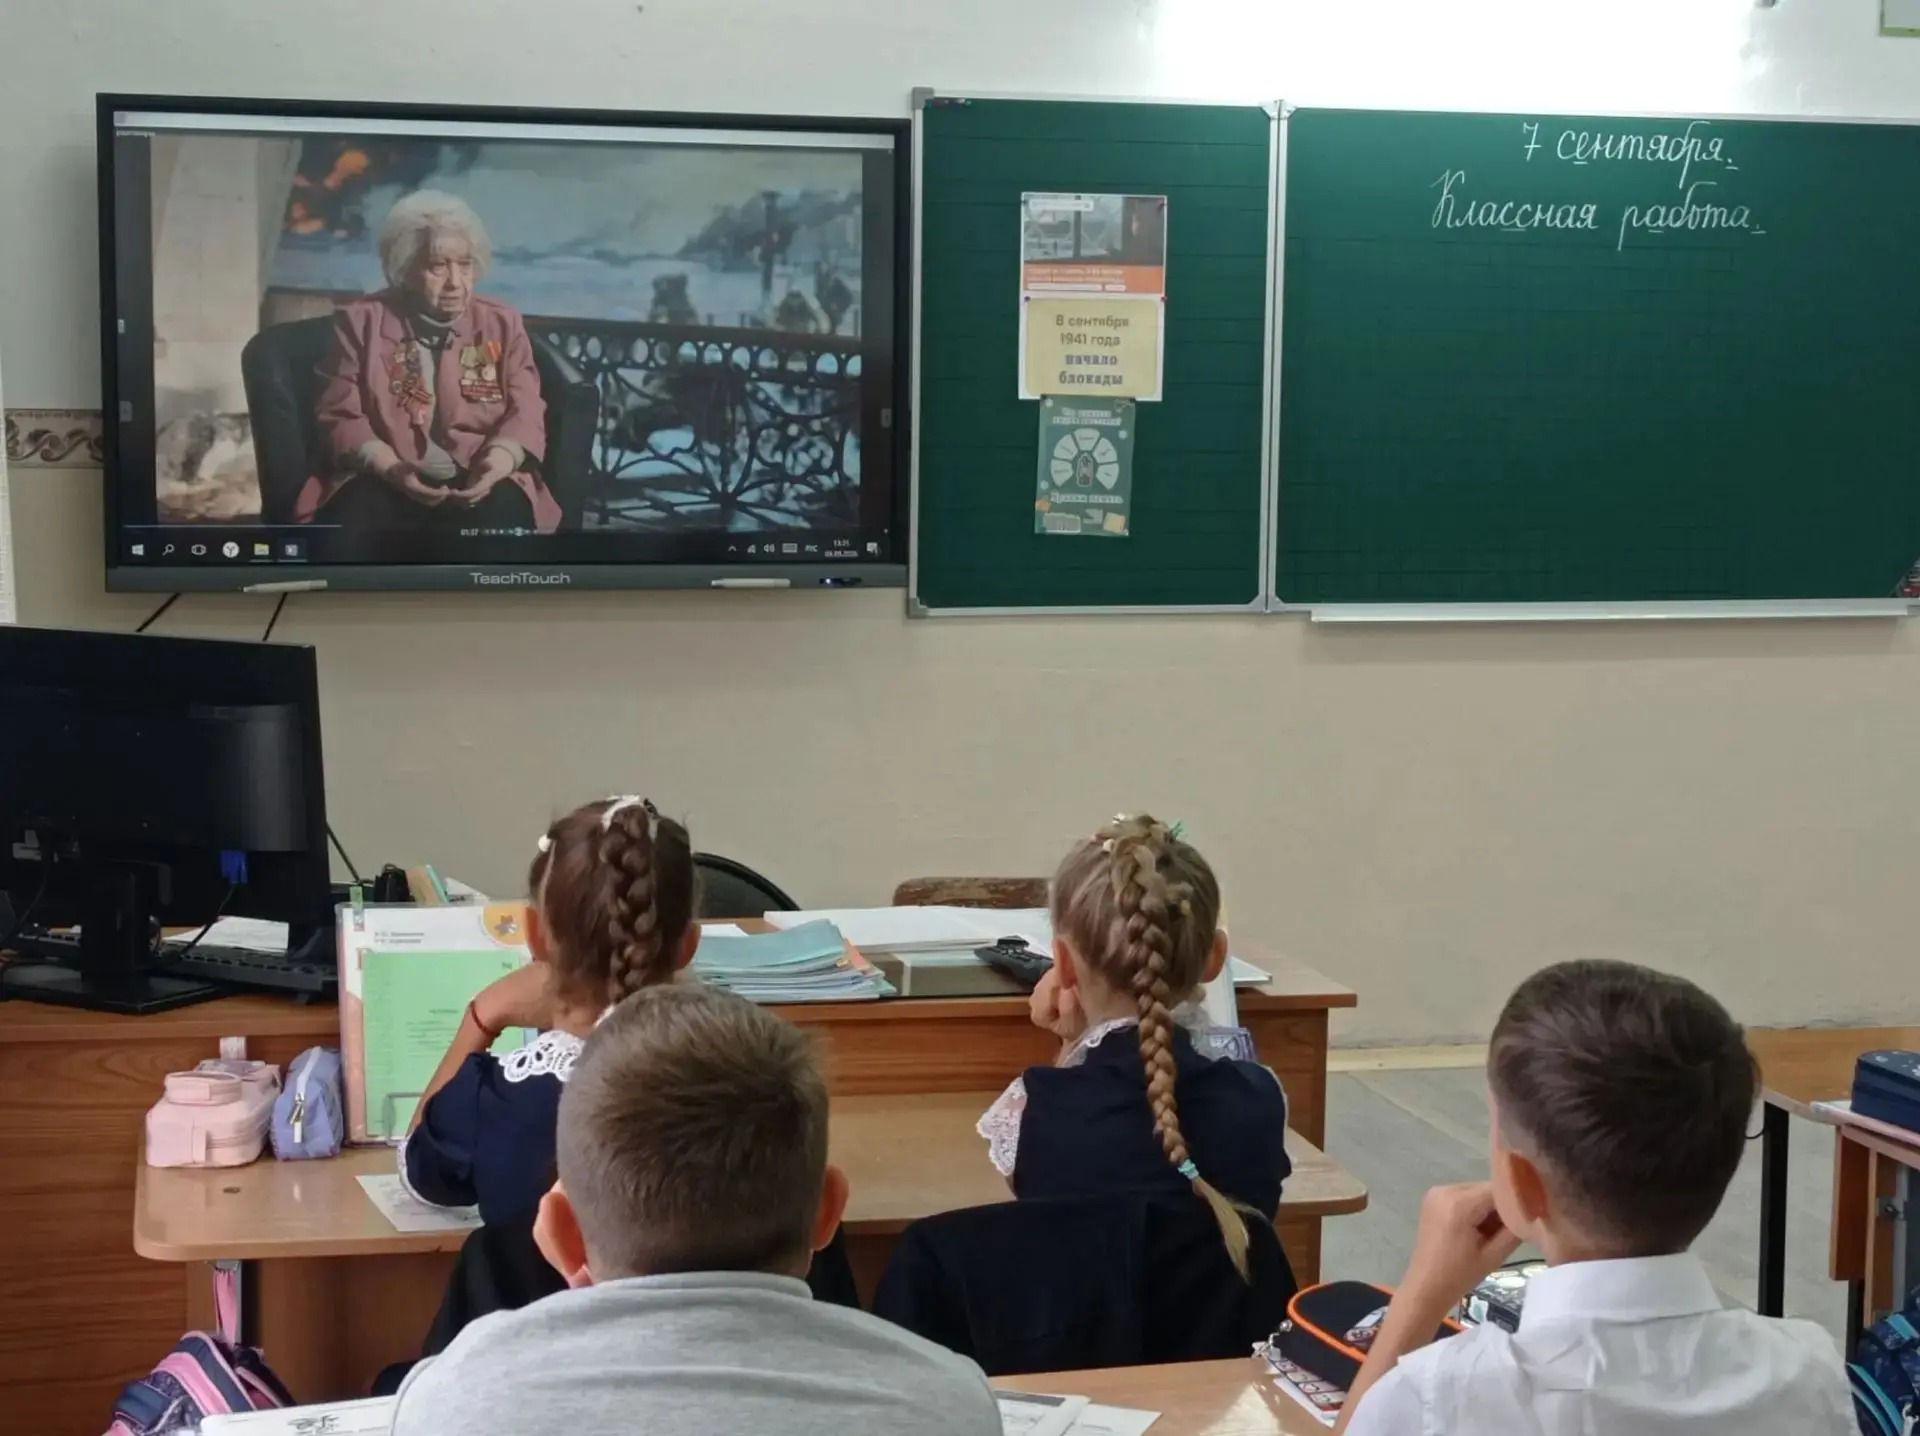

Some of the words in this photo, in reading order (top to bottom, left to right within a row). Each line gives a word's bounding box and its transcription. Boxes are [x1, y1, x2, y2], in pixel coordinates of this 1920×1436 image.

[1523, 122, 1542, 161] 7
[1556, 120, 1738, 189] сентября.
[1430, 169, 1599, 231] Классная
[1067, 315, 1130, 330] сентября
[1060, 332, 1087, 345] 1941
[1091, 336, 1121, 347] года
[1065, 354, 1119, 366] начало
[1058, 370, 1124, 386] блокады
[468, 571, 572, 586] TeachTouch
